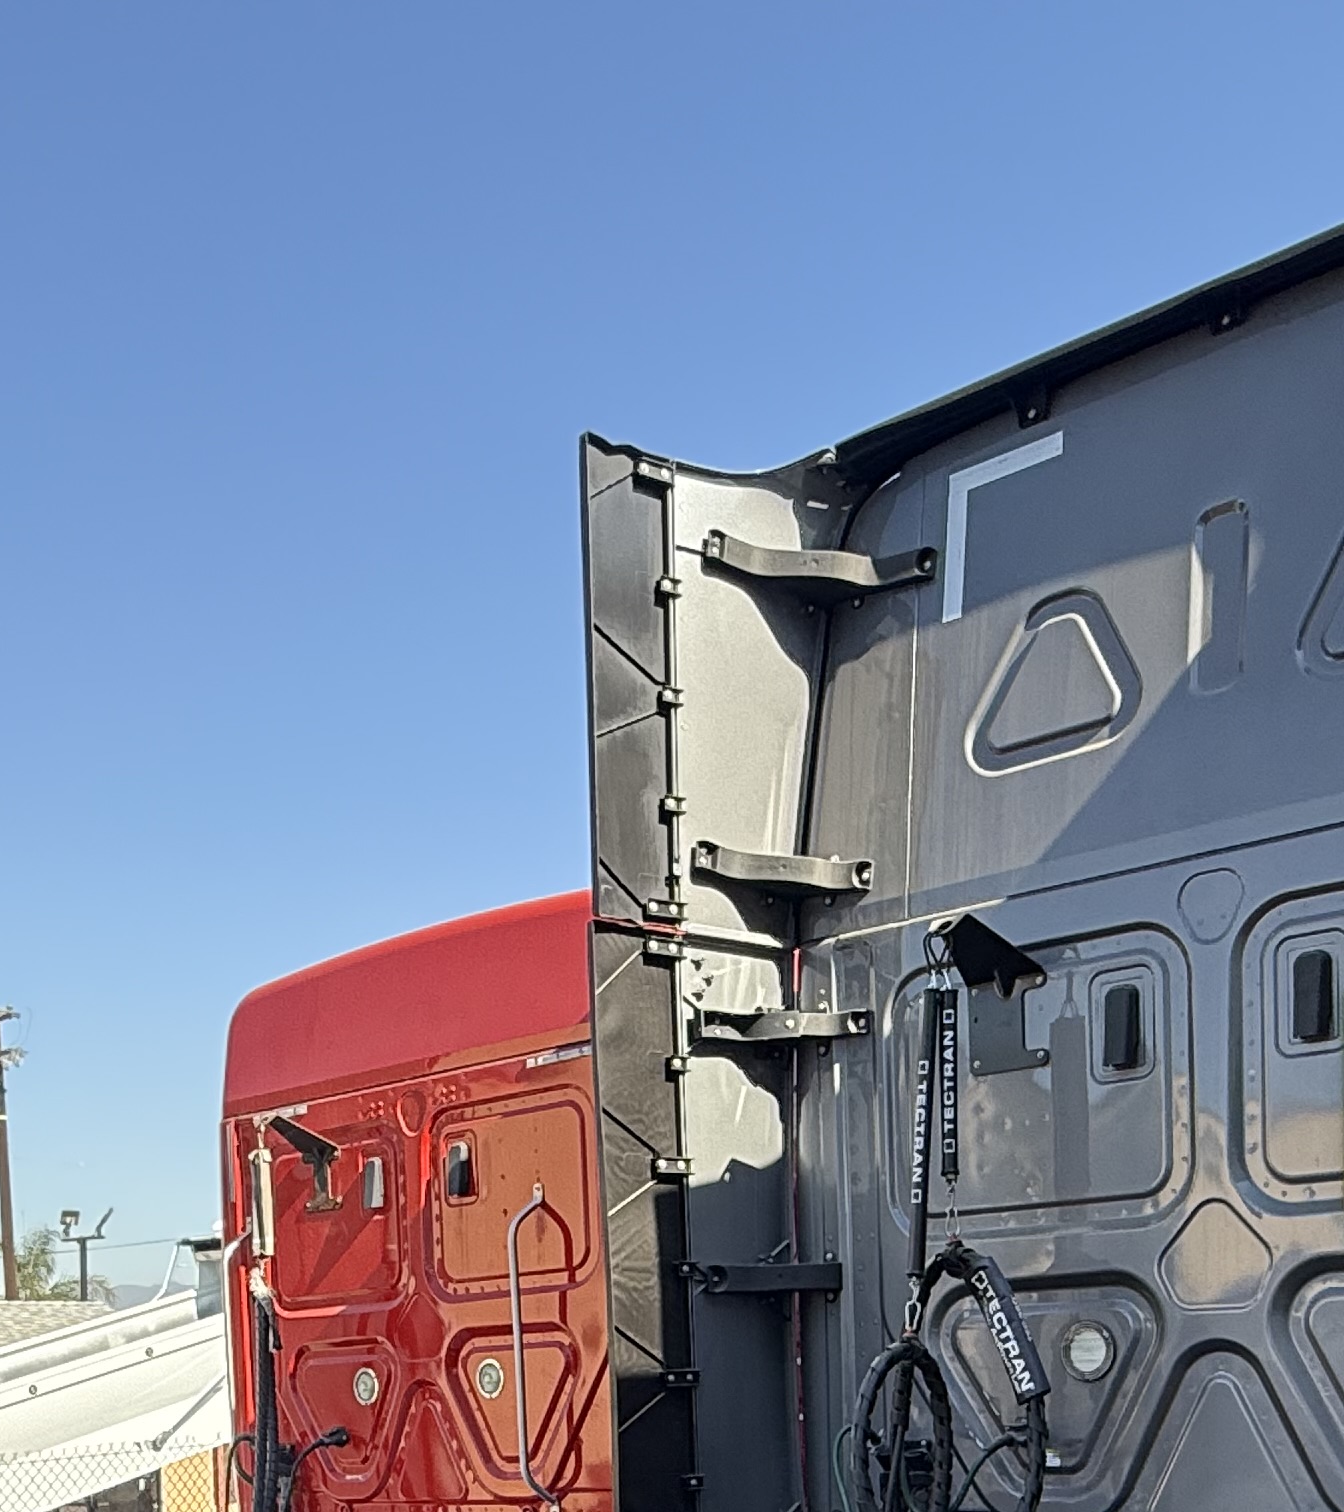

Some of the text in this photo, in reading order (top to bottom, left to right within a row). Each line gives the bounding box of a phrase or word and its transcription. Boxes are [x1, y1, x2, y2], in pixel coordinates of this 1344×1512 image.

[912, 1080, 928, 1183] TECTRAN
[943, 1030, 955, 1134] TECTRAN
[985, 1283, 1035, 1392] TECTRAN
